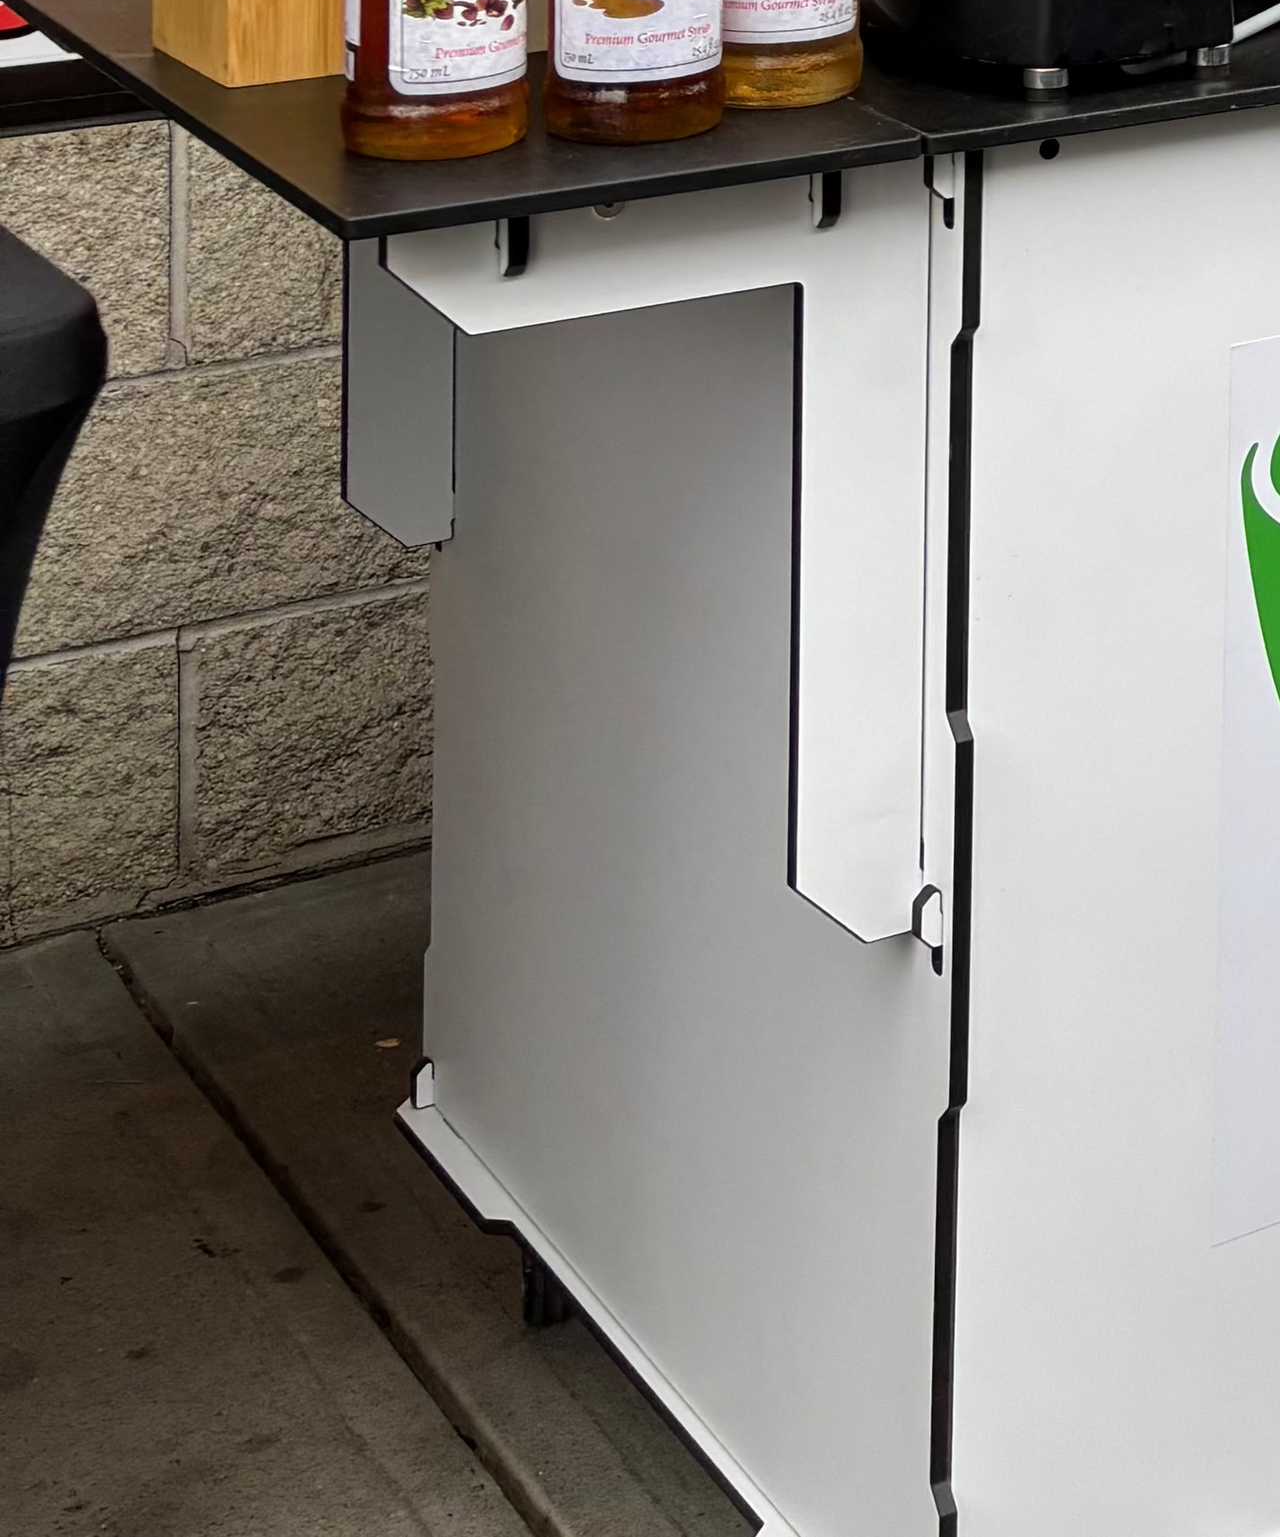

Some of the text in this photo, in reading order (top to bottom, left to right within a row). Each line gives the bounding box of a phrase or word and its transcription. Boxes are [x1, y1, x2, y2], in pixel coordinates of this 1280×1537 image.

[585, 32, 634, 46] Premium
[637, 29, 686, 45] Gourmet
[434, 46, 485, 60] Premium
[430, 65, 451, 78] mL
